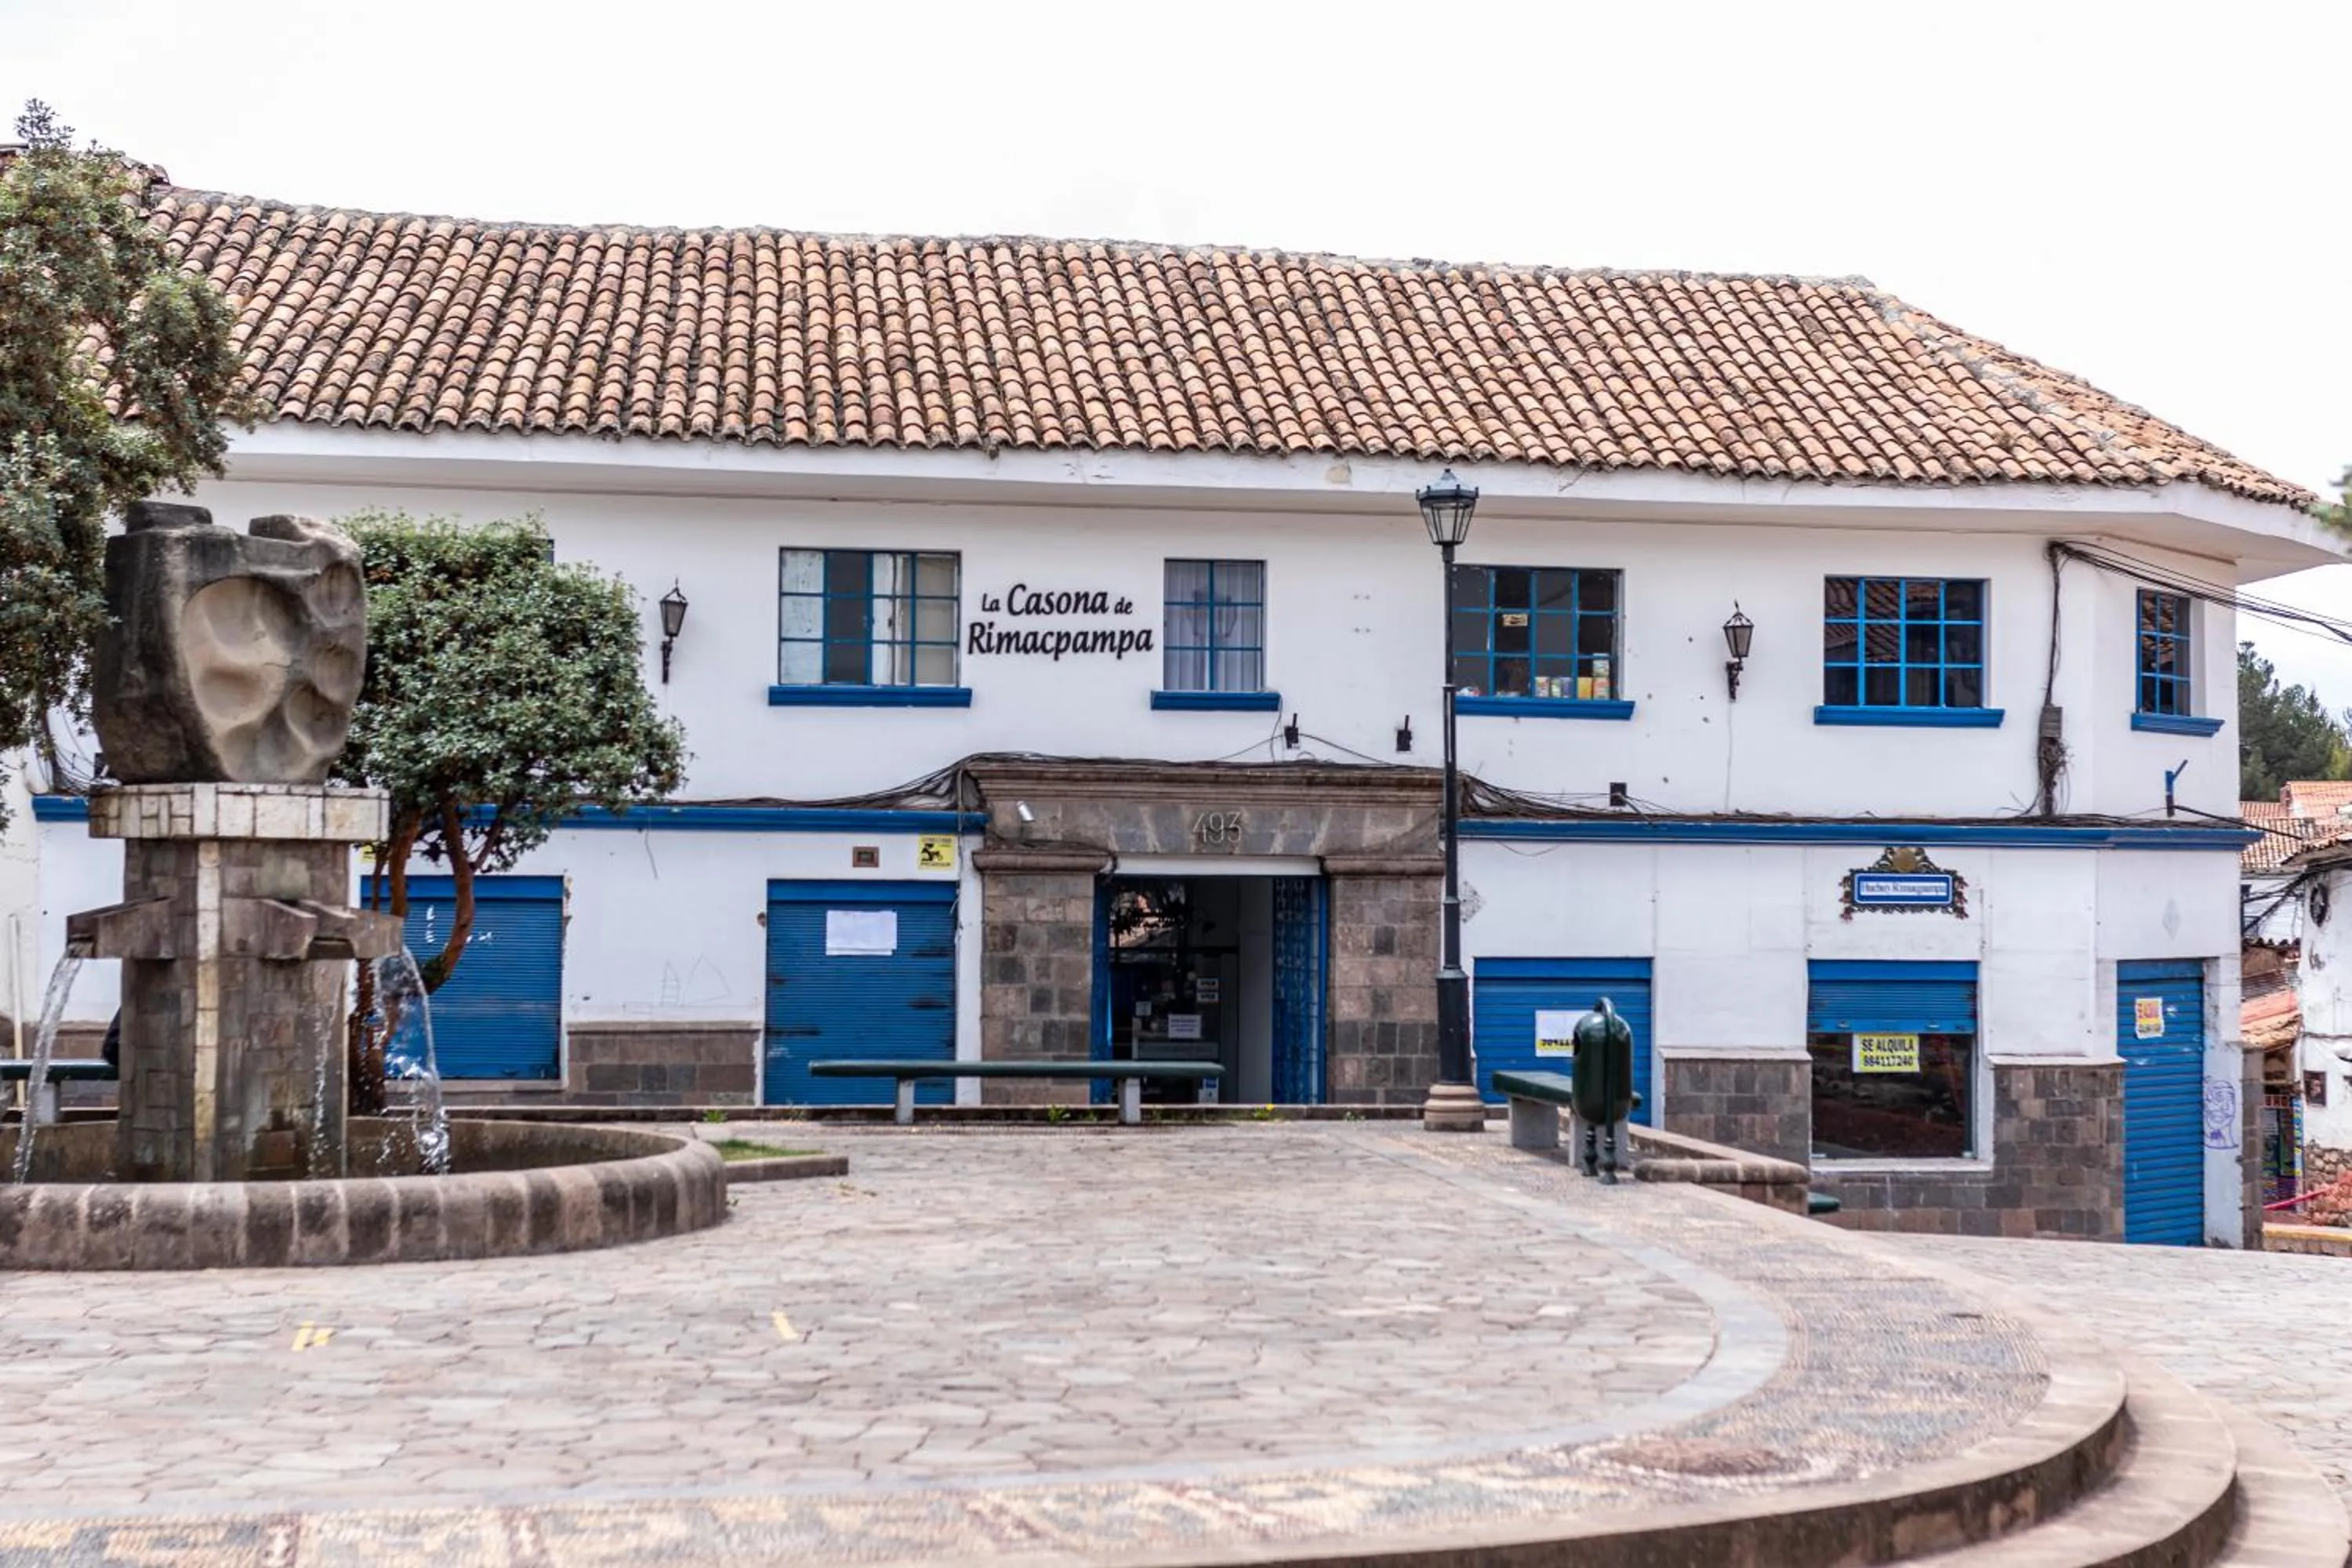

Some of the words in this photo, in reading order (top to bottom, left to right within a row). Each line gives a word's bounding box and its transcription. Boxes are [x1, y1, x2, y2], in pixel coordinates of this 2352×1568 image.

[982, 593, 1001, 612] La
[1007, 583, 1109, 616] Casona
[1114, 597, 1134, 615] de
[967, 622, 1154, 661] Rimacpampa
[1862, 1039, 1874, 1051] SE
[1877, 1039, 1914, 1053] ALQUILA
